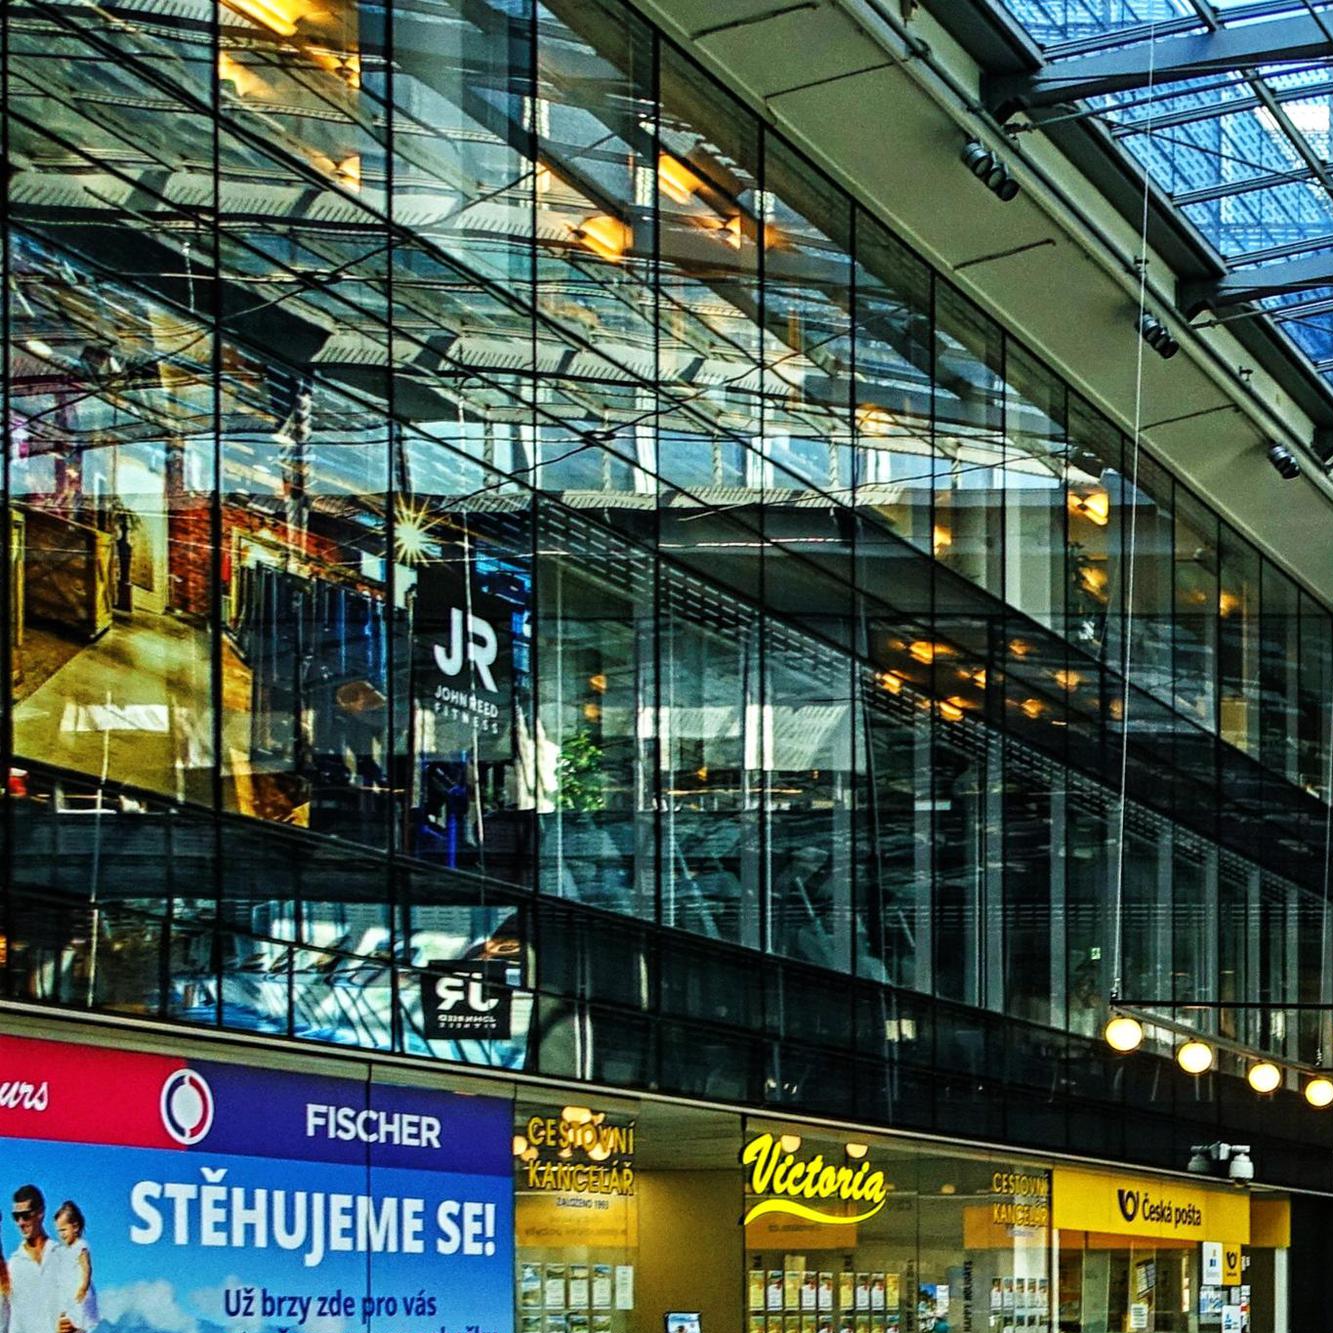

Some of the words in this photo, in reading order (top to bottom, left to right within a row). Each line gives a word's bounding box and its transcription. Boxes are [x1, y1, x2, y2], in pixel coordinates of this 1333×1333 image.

[433, 607, 499, 693] JR
[434, 684, 468, 707] JOHN
[434, 702, 499, 735] FITNESS
[306, 1102, 442, 1149] FISCHER
[526, 1115, 636, 1155] CESTOVNÍ
[526, 1158, 635, 1196] KANCELÁŘ
[742, 1133, 887, 1204] Victoria
[130, 1166, 425, 1268] STĚHUJEME
[437, 1199, 496, 1257] SE!
[1142, 1193, 1172, 1223] Česká
[1174, 1202, 1201, 1229] pošta
[224, 1287, 255, 1317] Už
[261, 1288, 313, 1326] brzy
[317, 1288, 355, 1317] zde
[361, 1295, 398, 1325] pro
[402, 1289, 438, 1317] vás
